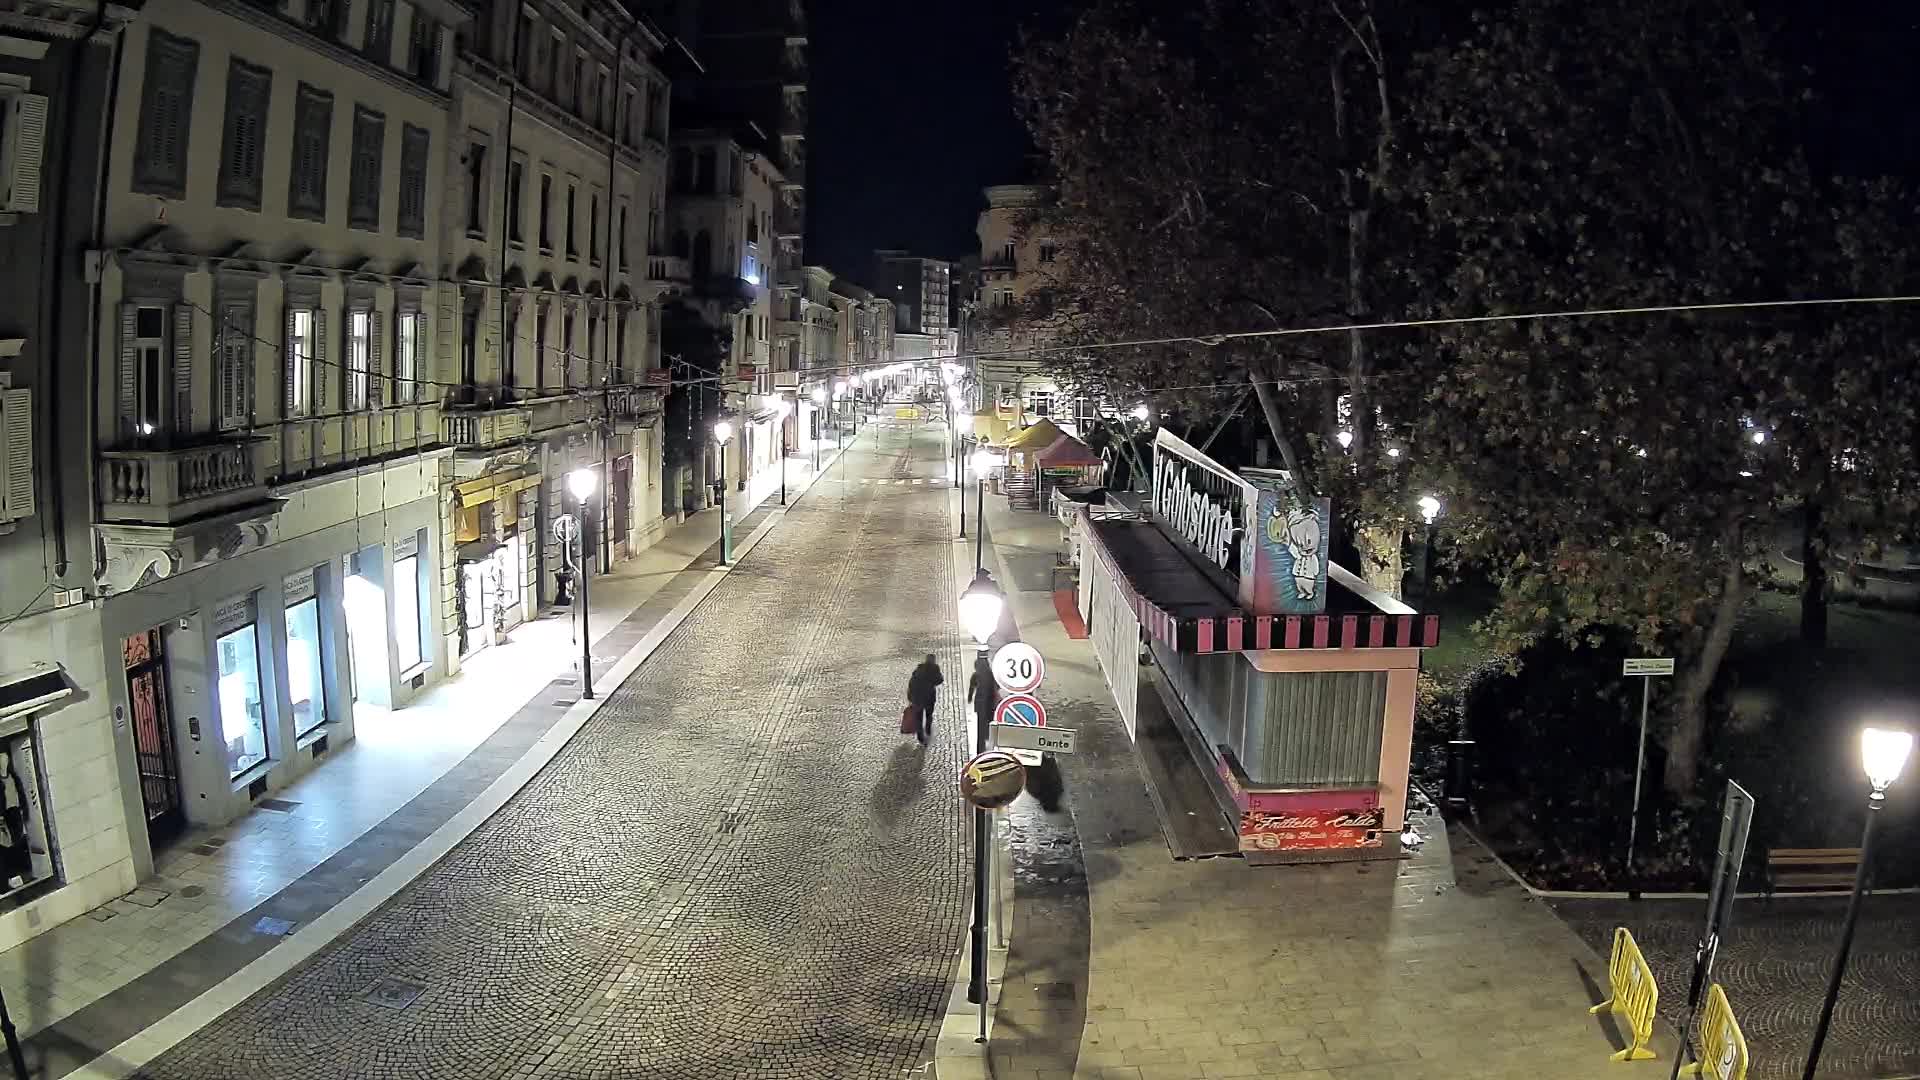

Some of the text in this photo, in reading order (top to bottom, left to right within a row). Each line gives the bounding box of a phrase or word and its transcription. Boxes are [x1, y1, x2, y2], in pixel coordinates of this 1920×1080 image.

[1162, 458, 1233, 570] Golosone
[1006, 658, 1032, 679] 30
[1038, 737, 1070, 749] Dante
